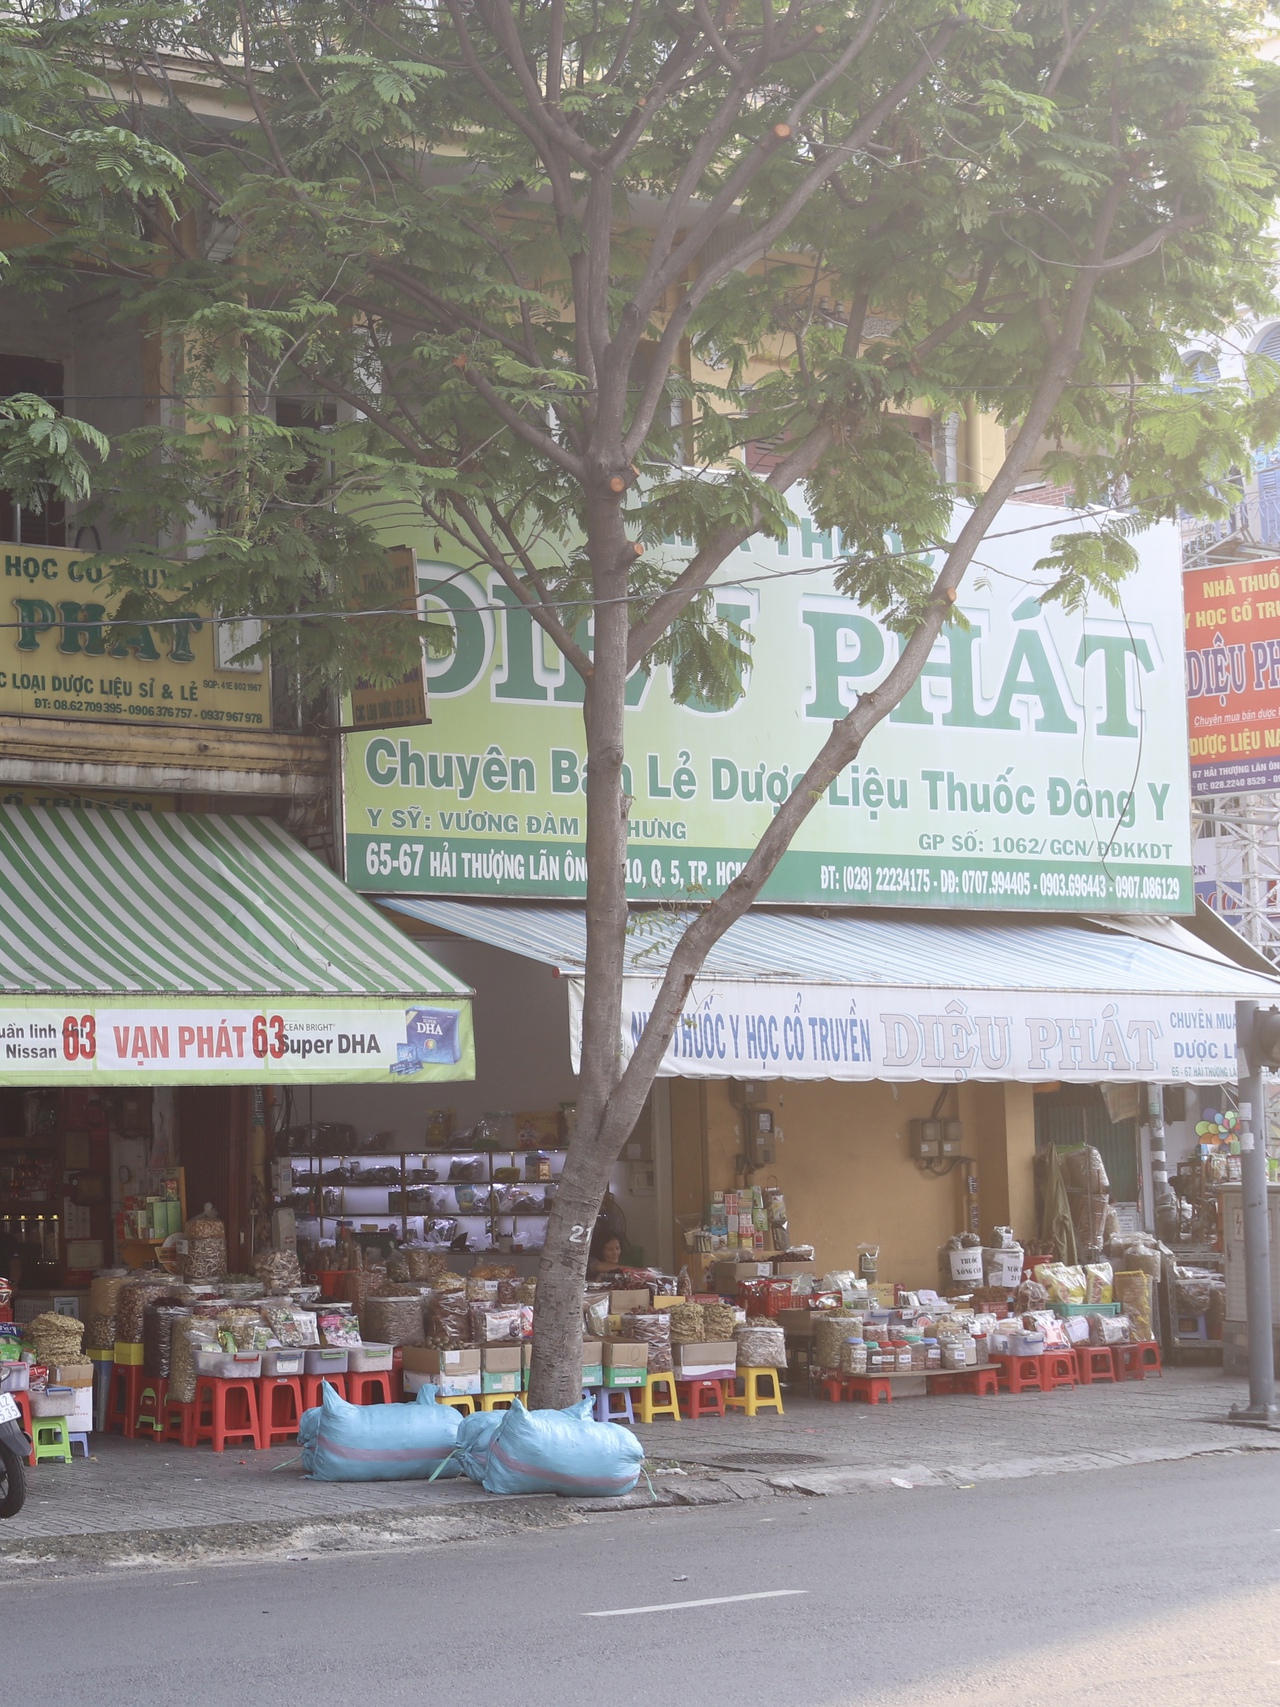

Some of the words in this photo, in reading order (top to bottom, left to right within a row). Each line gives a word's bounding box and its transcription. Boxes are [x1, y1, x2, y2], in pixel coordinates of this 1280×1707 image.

[5, 555, 58, 583] HỌC
[1203, 575, 1236, 599] NHÀ
[1195, 608, 1227, 630] HỌC
[1231, 597, 1253, 622] CỔ
[801, 588, 1158, 739] PHÁT
[1186, 631, 1246, 707] DIỆU
[12, 673, 46, 694] LOẠI
[52, 674, 94, 697] DƯỢC
[100, 676, 132, 699] LIỆU
[139, 678, 155, 698] SỈ
[162, 684, 173, 700] &
[180, 681, 198, 701] LẺ
[203, 680, 220, 689] SGP:
[34, 698, 51, 709] ĐT:
[1194, 713, 1223, 727] Chuyên
[1224, 713, 1240, 723] mua
[1242, 709, 1256, 721] bán
[1189, 733, 1227, 758] DƯỢC
[1230, 727, 1261, 755] LIỆU
[365, 736, 537, 800] Chuyên
[647, 749, 698, 800] Lẻ
[829, 764, 909, 822] Liệu
[921, 767, 1035, 815] Thuốc
[1047, 776, 1137, 828] Đông
[1146, 781, 1170, 822] Y
[1204, 766, 1217, 777] HẢI
[1219, 764, 1250, 776] THƯỢNG
[1251, 762, 1267, 772] LÃN
[1210, 779, 1245, 790] 028.2240
[1247, 776, 1266, 786] 8529
[367, 808, 383, 828] Y
[391, 805, 431, 830] SỸ:
[438, 809, 519, 835] VƯƠNG
[526, 811, 579, 836] ĐÀM
[918, 833, 945, 852] GP
[951, 829, 984, 853] SỐ:
[366, 842, 424, 877] 65-67
[430, 841, 457, 877] HẢI
[462, 850, 525, 885] THƯỢNG
[530, 850, 560, 882] LÃN
[688, 860, 711, 886] TP.
[821, 865, 840, 890] ĐT:
[843, 866, 872, 893] (028)
[876, 866, 930, 893] 22234175
[962, 870, 1030, 896] 0707.994405
[1040, 873, 1106, 899] 0903.696443
[1116, 876, 1180, 901] 0907.086129
[29, 1022, 57, 1039] linh
[416, 1022, 443, 1035] DHA
[1170, 1008, 1213, 1029] CHUYÊN
[62, 1015, 96, 1061] 63
[113, 1025, 170, 1066] VẠN
[178, 1019, 247, 1059] PHÁT
[252, 1014, 285, 1060] 63
[282, 1033, 333, 1059] Super
[338, 1033, 381, 1054] DHA
[730, 1012, 740, 1058] Y
[747, 1012, 782, 1069] HỌC
[785, 992, 805, 1062] CỔ
[808, 997, 872, 1063] TRUYỀN
[879, 1000, 1014, 1081] DIỆU
[1026, 1004, 1163, 1071] PHÁT
[6, 1043, 57, 1059] Nissan
[1173, 1039, 1218, 1062] DƯỢC
[569, 1225, 591, 1243] 21
